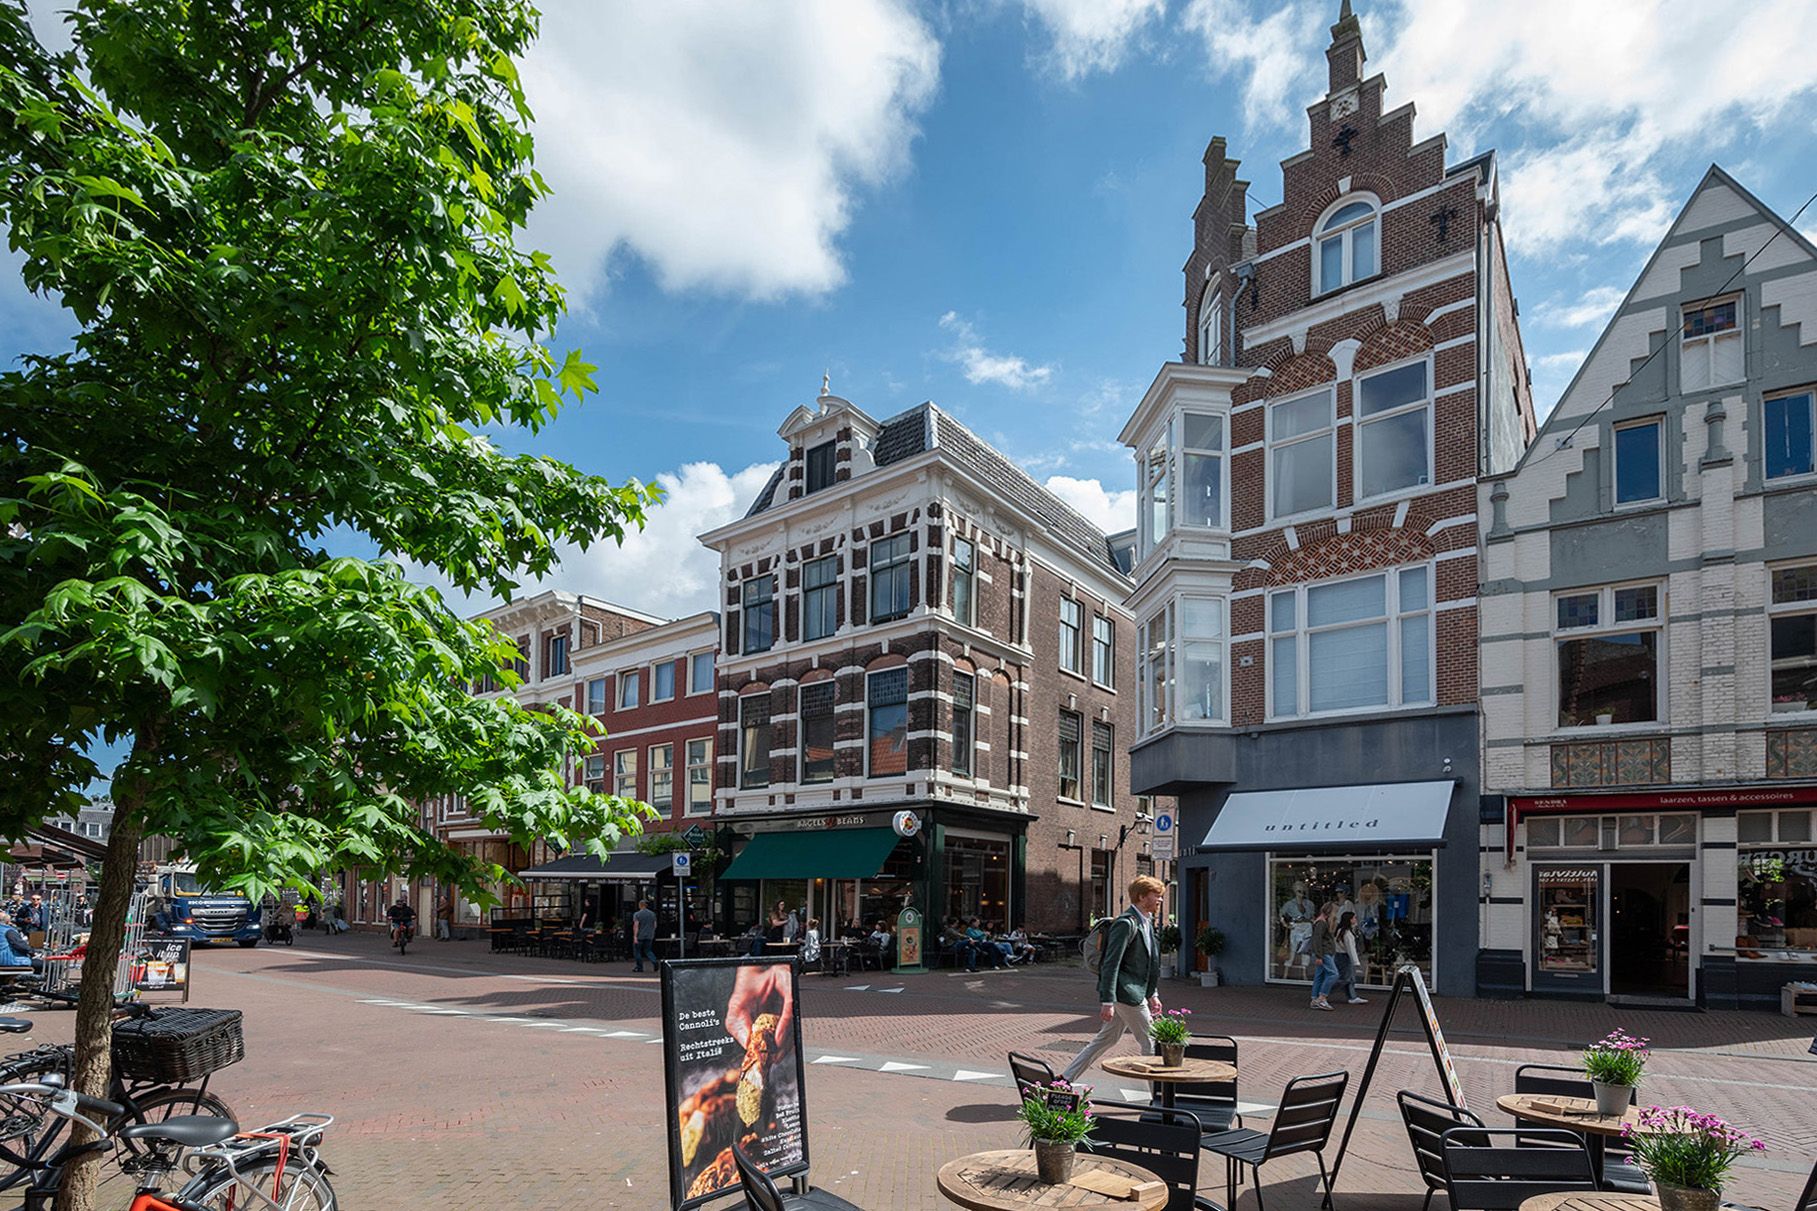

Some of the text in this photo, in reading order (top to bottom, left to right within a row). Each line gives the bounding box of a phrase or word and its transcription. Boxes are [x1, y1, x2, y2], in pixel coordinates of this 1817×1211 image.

[1659, 791, 1794, 804] laarzen, tassen & accessoires
[1264, 818, 1379, 832] untitled
[679, 1009, 716, 1020] De beste
[679, 1018, 720, 1031] Cannoli's
[680, 1035, 735, 1052] Rechtstreeks
[680, 1046, 723, 1062] uit Italië
